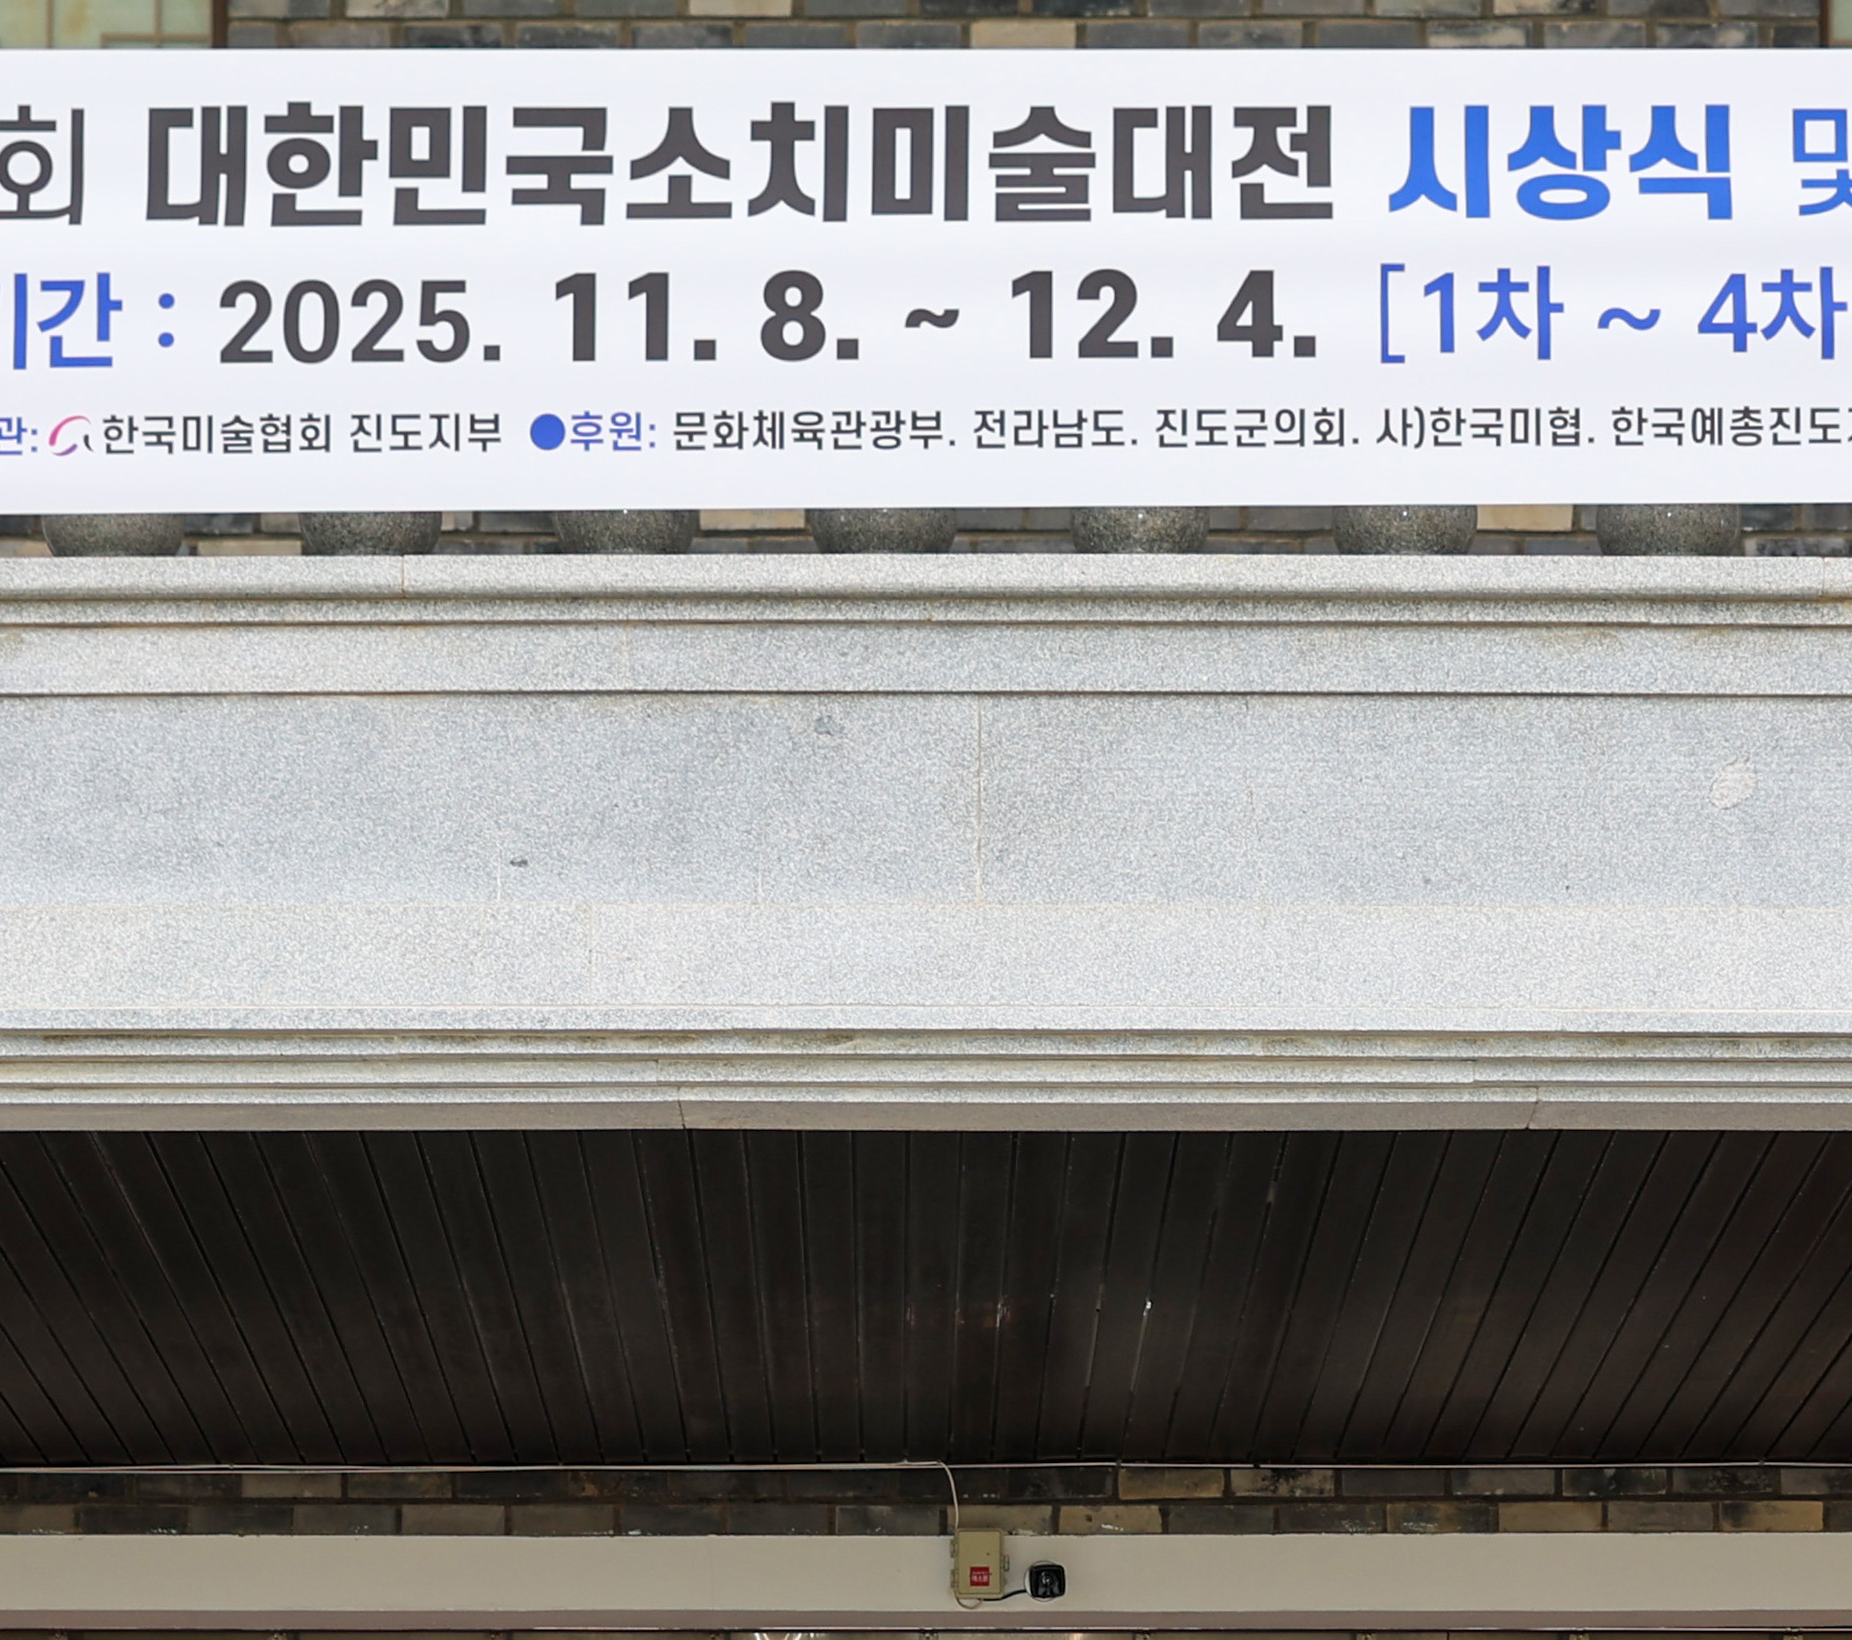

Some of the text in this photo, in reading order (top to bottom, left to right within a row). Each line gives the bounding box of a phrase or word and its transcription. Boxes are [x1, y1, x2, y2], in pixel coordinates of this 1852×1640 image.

[146, 102, 1334, 227] 대한민국소치미술대전
[1389, 105, 1733, 221] 시상식
[220, 279, 501, 364] 2025.
[556, 272, 717, 362] 11.
[761, 270, 859, 362] 8.
[1012, 268, 1174, 359] 12.
[1217, 269, 1317, 358] 4.
[1380, 263, 1565, 364] [1차
[1697, 266, 1848, 360] 4차
[103, 413, 331, 455] 한국미술협회
[351, 413, 502, 453] 진도지부
[570, 410, 656, 452] 후원:
[674, 409, 956, 451] 문화체육관광부.
[974, 409, 1138, 449] 전라남도.
[1156, 407, 1359, 448] 진도군의회.
[1377, 406, 1595, 449] 사)한국미협.
